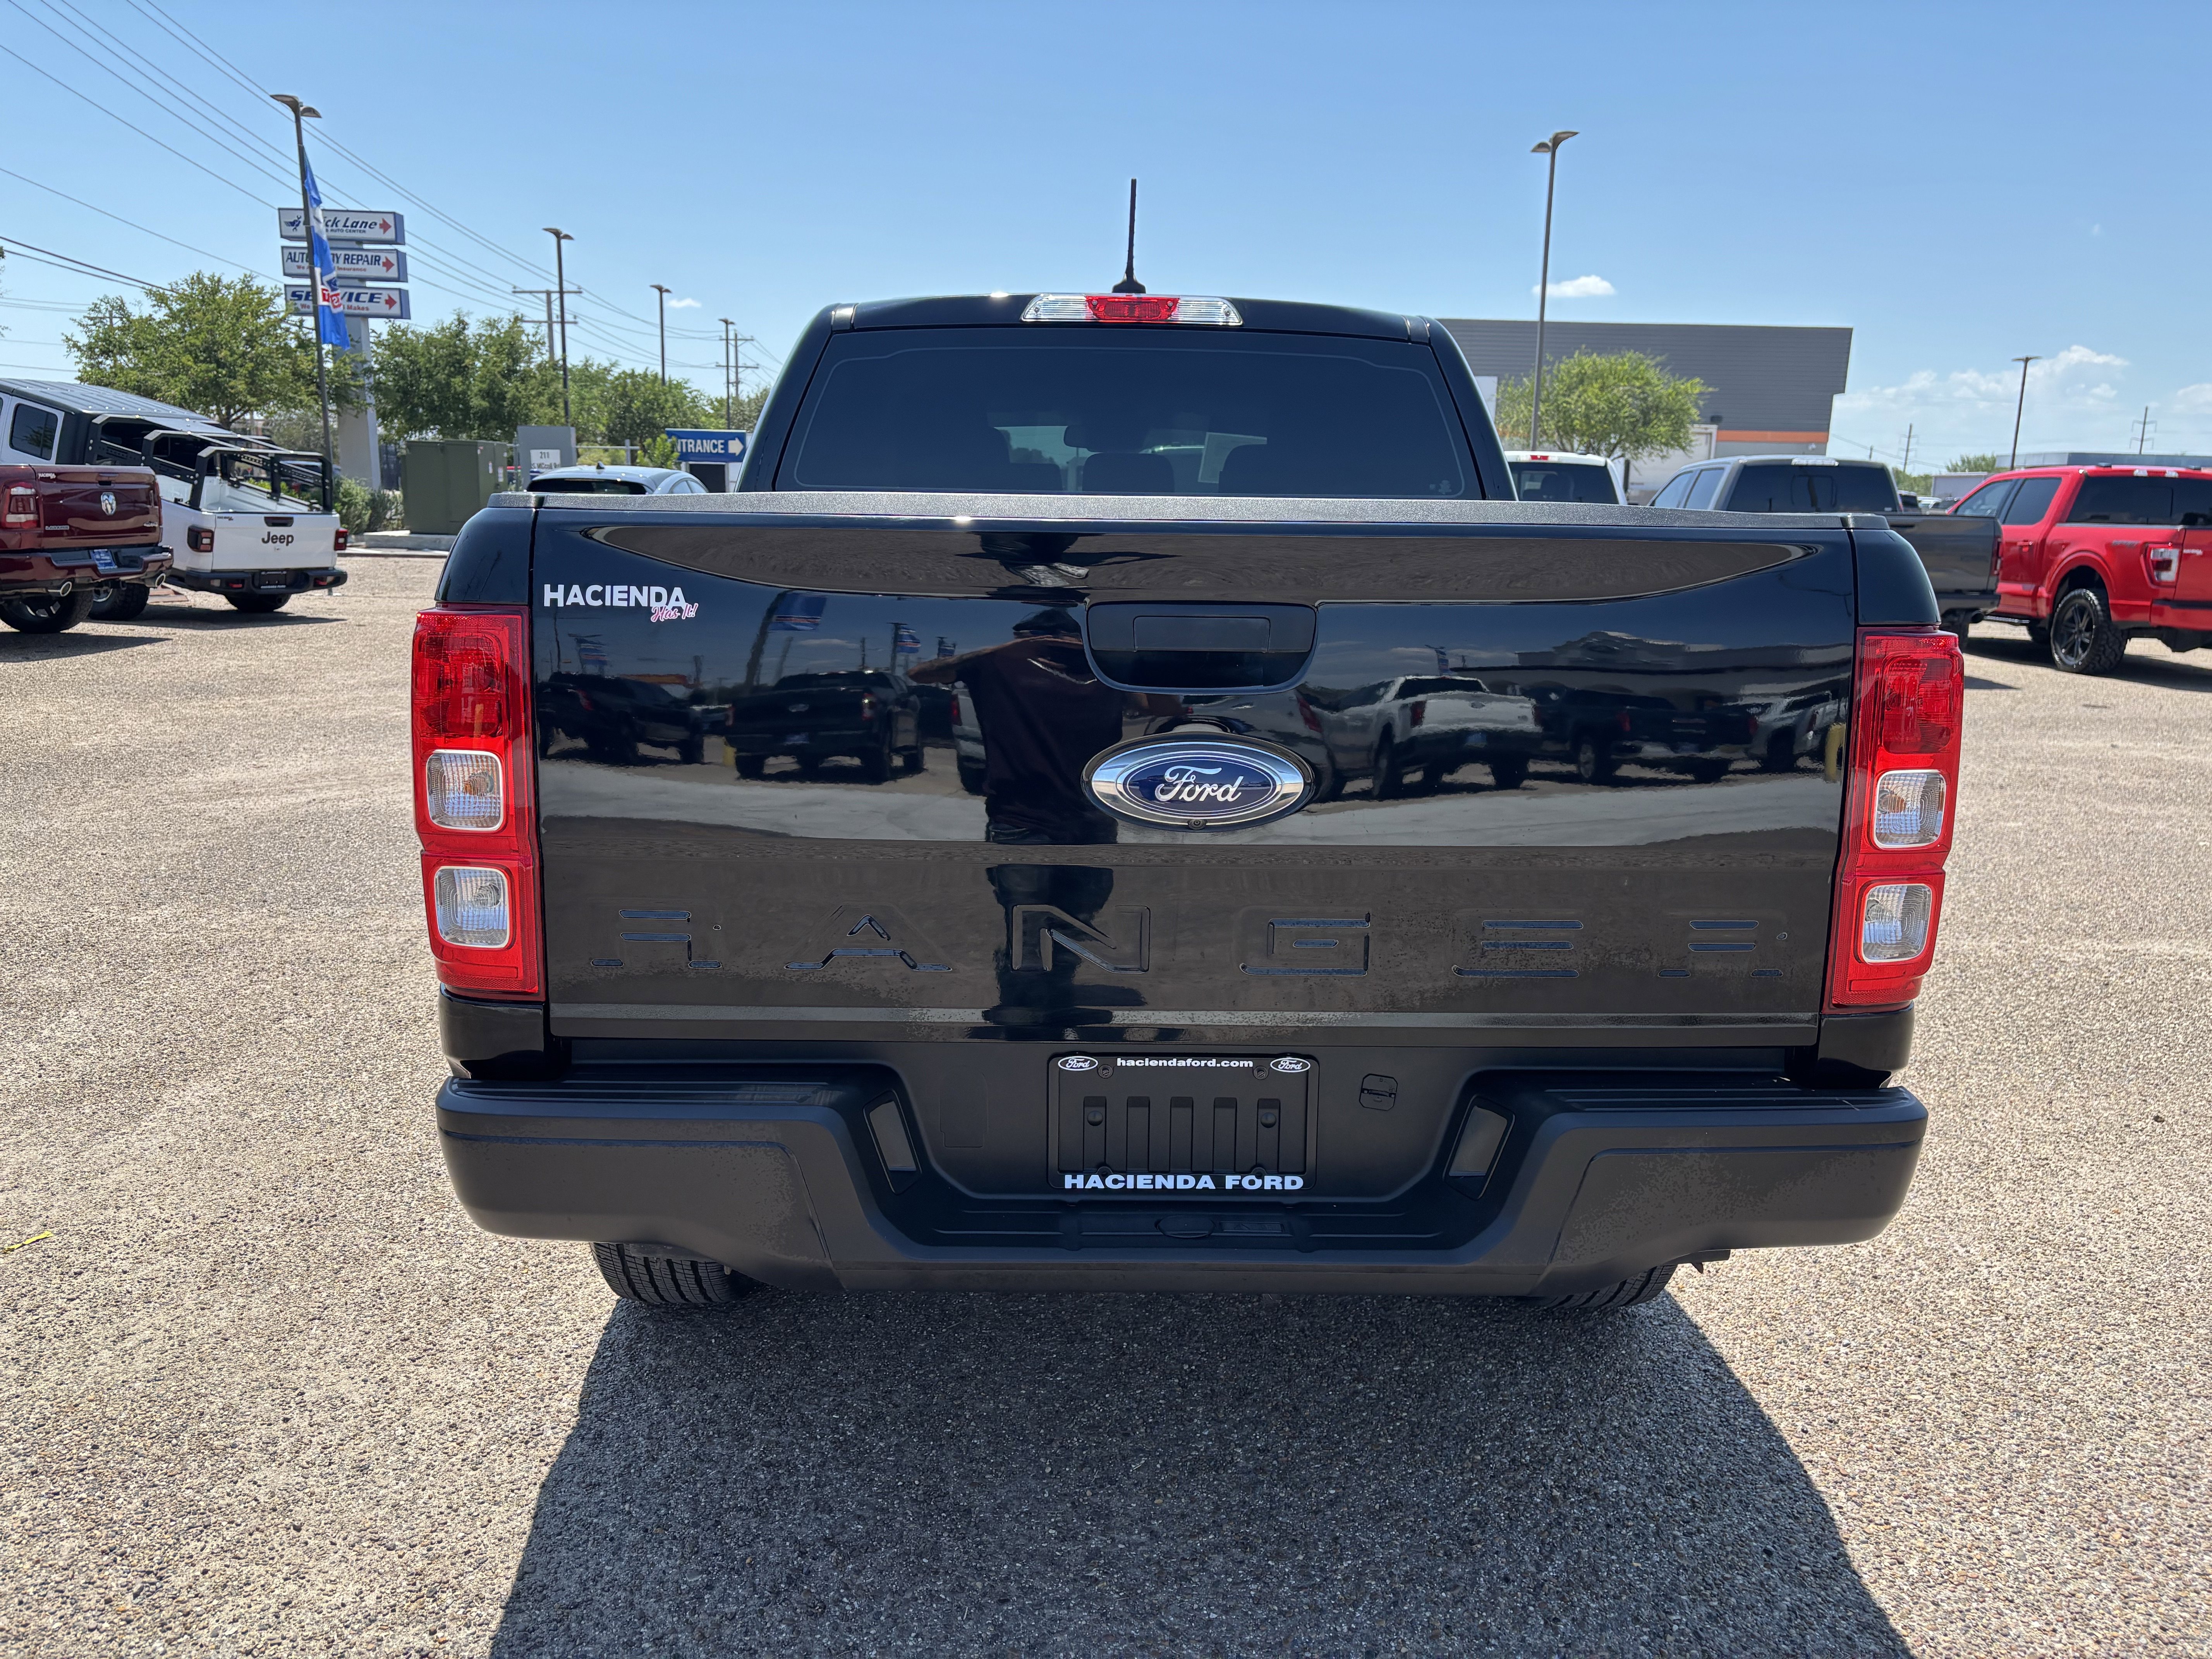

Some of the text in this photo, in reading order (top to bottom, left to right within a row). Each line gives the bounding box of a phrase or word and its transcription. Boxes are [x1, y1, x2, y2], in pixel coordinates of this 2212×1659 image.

[342, 217, 377, 229] Lane
[343, 254, 381, 266] REPAIR
[290, 290, 382, 303] SEVICE
[674, 439, 725, 453] NTRANCE
[261, 531, 294, 546] Jeep
[544, 584, 686, 608] HACIENDA
[651, 603, 699, 622] Has It!
[1155, 765, 1245, 802] Ford
[585, 898, 1788, 977] RANGER
[1066, 1058, 1090, 1068] Ford
[1116, 1057, 1253, 1067] haciendaford.com
[1278, 1060, 1303, 1070] Ford
[1065, 1174, 1304, 1190] HACIENDA FORD
